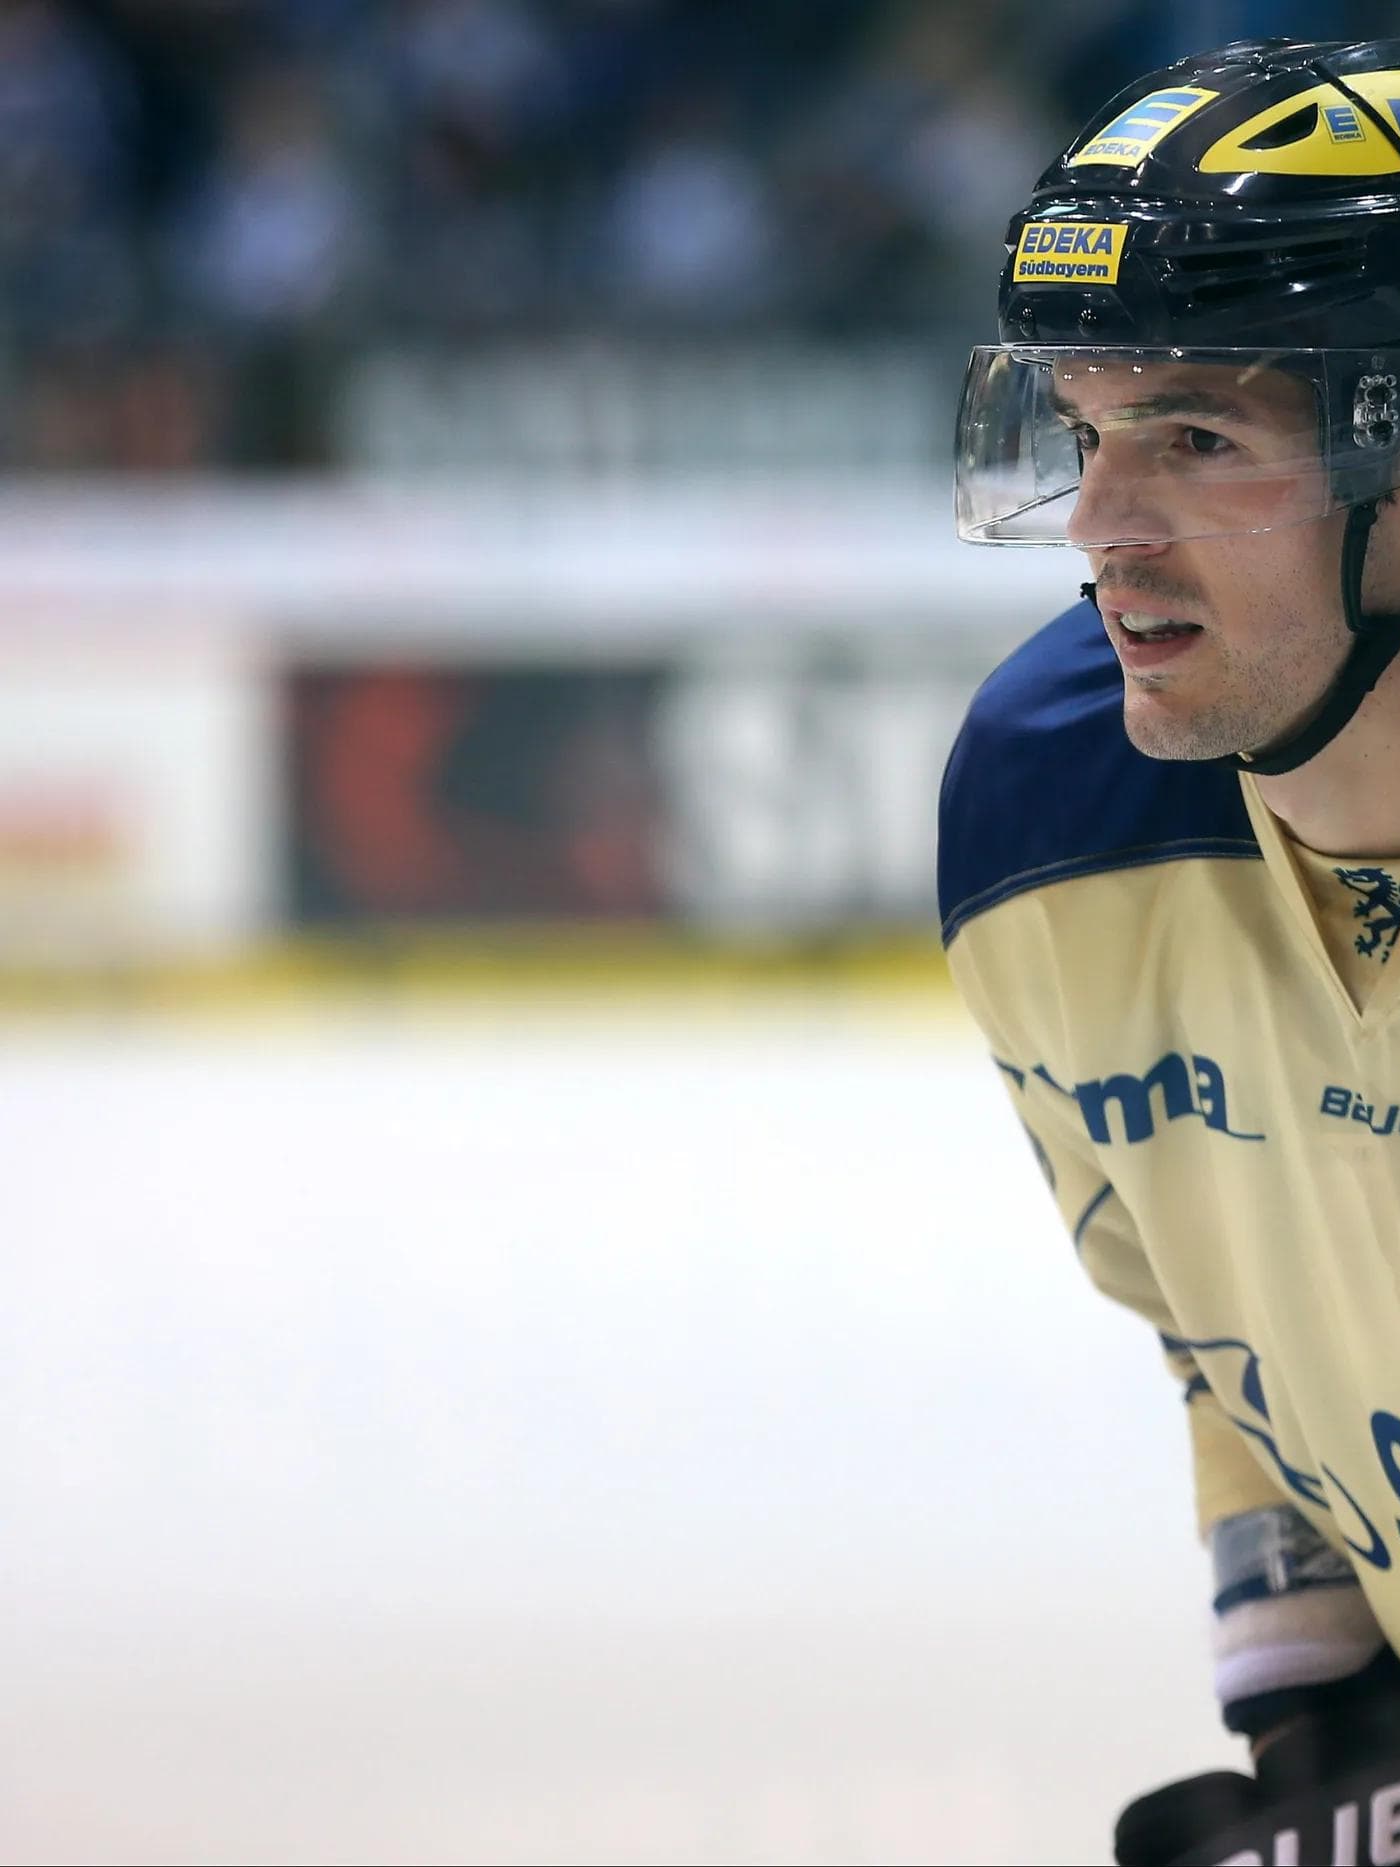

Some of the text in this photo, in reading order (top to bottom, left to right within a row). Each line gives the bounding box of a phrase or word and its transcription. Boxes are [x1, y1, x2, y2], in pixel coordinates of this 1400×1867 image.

[1083, 142, 1140, 157] EDEKA
[1022, 227, 1113, 255] EDEKA
[1019, 260, 1109, 278] Südbayern
